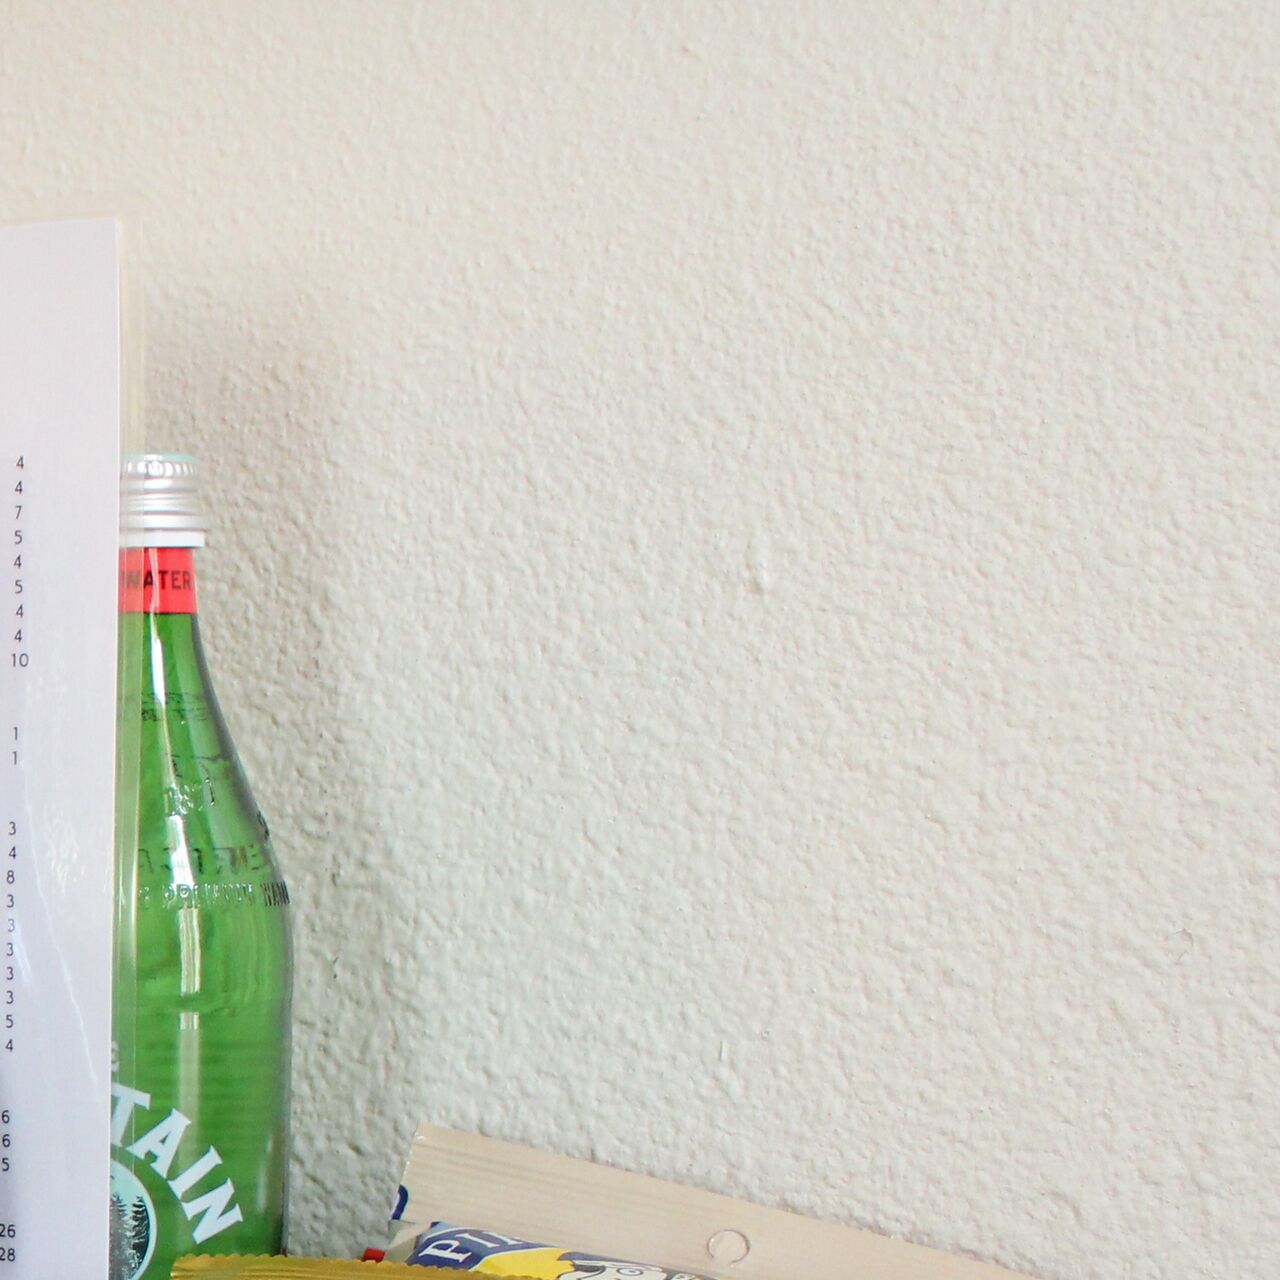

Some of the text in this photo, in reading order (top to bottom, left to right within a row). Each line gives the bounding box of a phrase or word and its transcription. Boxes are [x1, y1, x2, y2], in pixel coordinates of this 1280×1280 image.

[15, 454, 25, 470] 4
[14, 479, 24, 495] 4
[14, 504, 23, 520] 7
[13, 529, 24, 546] 5
[13, 554, 23, 569] 4
[14, 579, 24, 595] 5
[15, 603, 25, 619] 4
[13, 628, 23, 643] 4
[10, 652, 30, 668] 10
[12, 725, 19, 741] 1
[11, 750, 18, 766] 1
[8, 821, 18, 836] 3
[8, 845, 18, 860] 4
[5, 869, 16, 885] 8
[6, 893, 15, 909] 3
[5, 941, 15, 957] 3
[5, 965, 15, 981] 3
[5, 989, 15, 1005] 3
[4, 1013, 15, 1029] 5
[4, 1038, 15, 1053] 4
[0, 1108, 11, 1124] 6
[1, 1133, 12, 1149] 6
[0, 1156, 11, 1172] 5
[109, 1081, 244, 1246] TAIN
